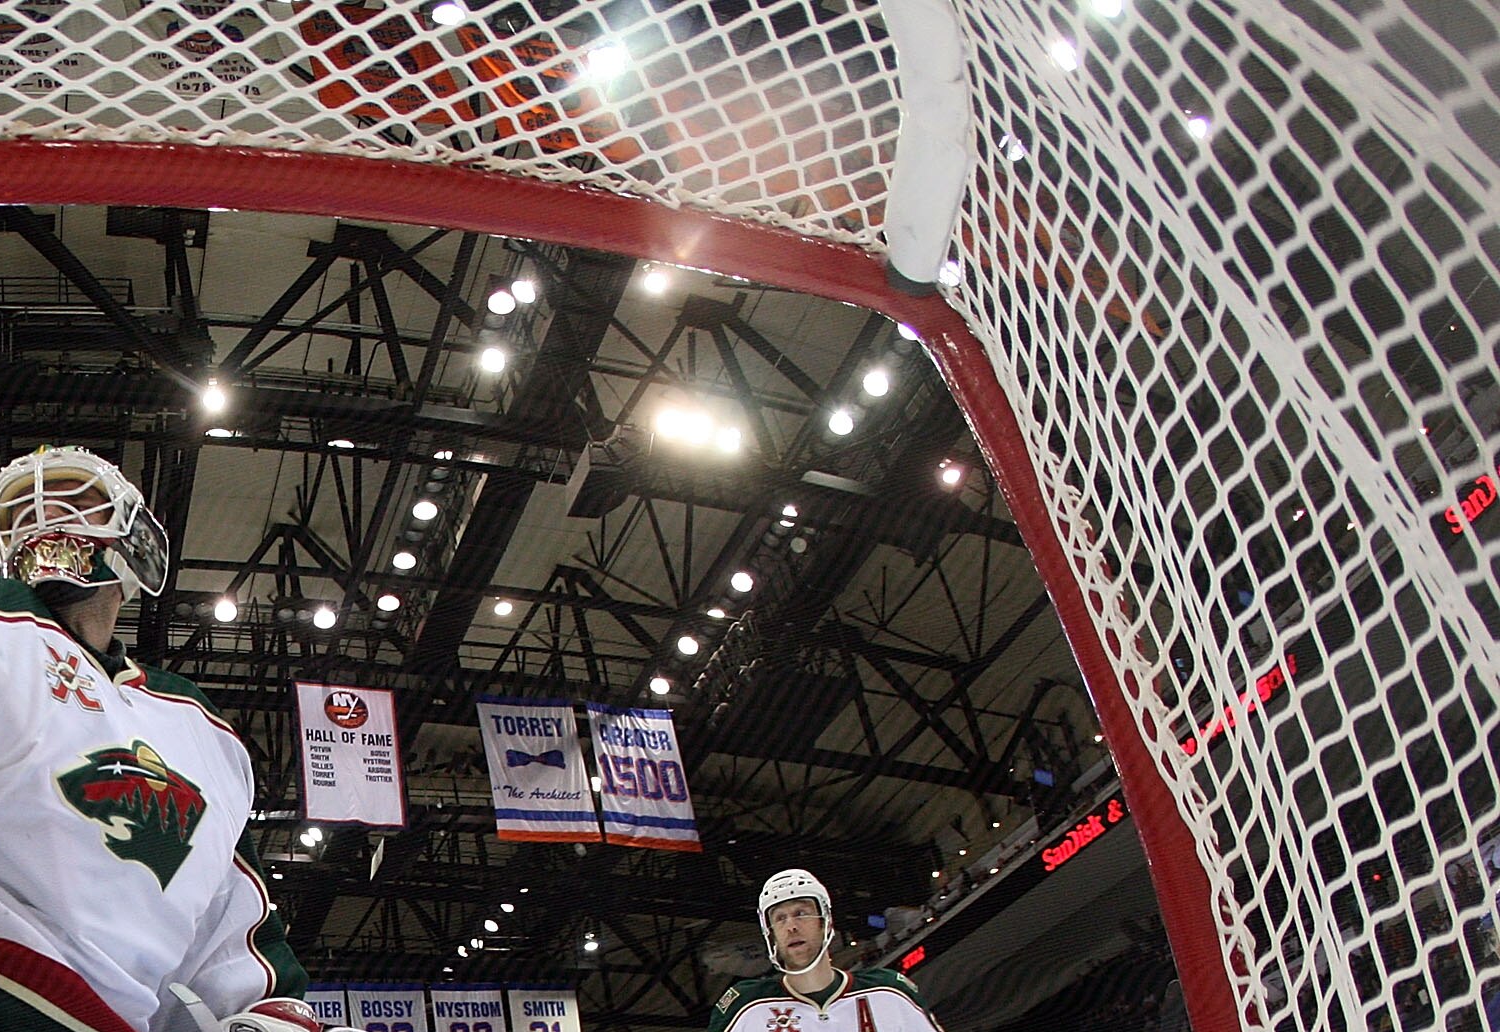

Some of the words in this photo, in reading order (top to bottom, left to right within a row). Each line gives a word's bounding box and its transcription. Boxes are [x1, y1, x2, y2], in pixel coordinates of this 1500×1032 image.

[491, 715, 563, 737] TORREY
[306, 729, 336, 743] HALL
[341, 731, 356, 744] OF
[361, 733, 393, 746] FAME
[599, 723, 672, 751] ARBOUR
[599, 752, 688, 803] 1500
[1041, 814, 1106, 872] SanDisk
[1107, 799, 1124, 823] &
[361, 1001, 413, 1018] BOSSY
[436, 1001, 502, 1018] NYSTROM
[523, 1001, 566, 1017] SMITH
